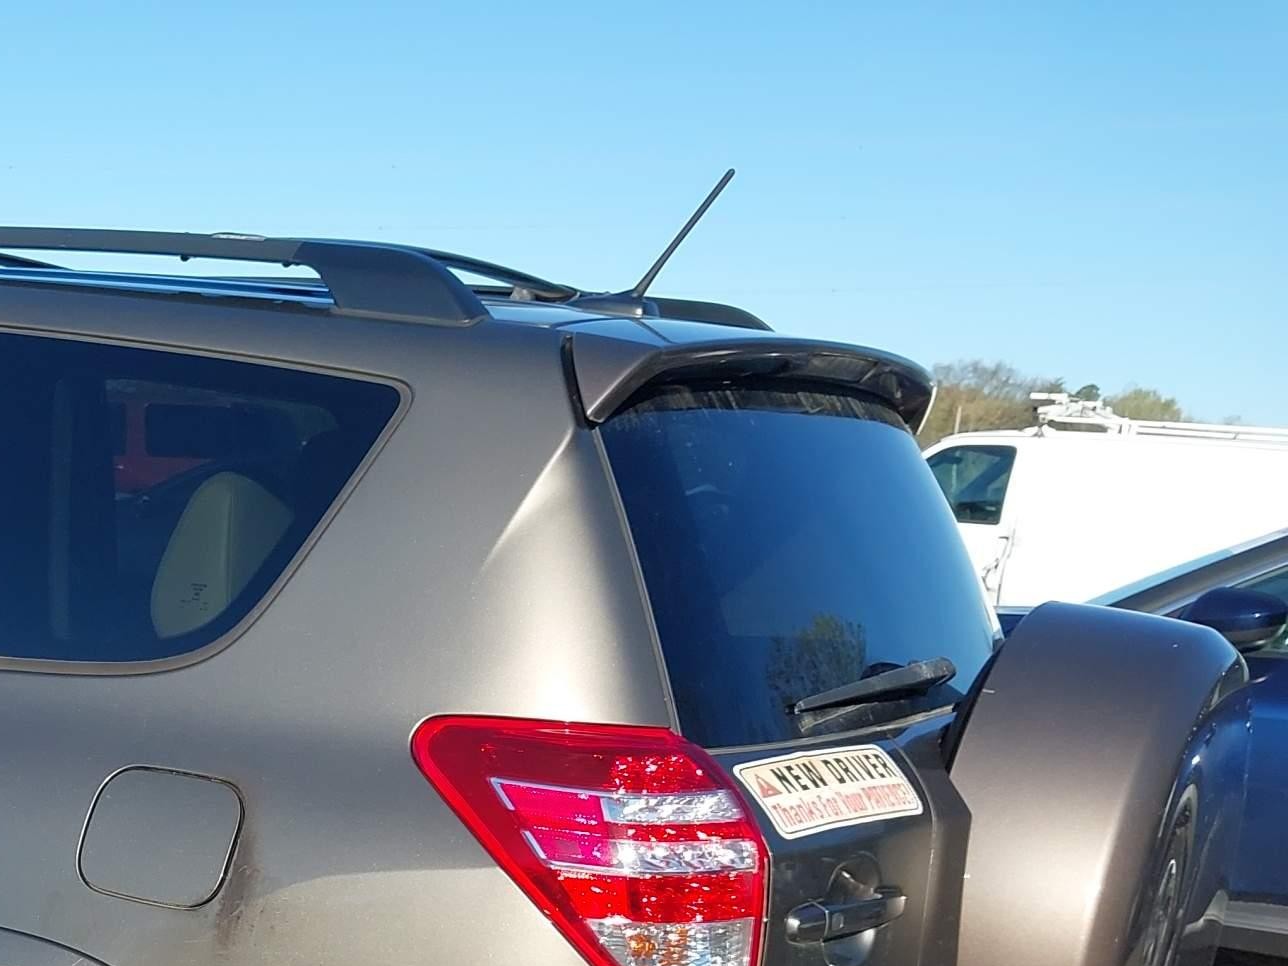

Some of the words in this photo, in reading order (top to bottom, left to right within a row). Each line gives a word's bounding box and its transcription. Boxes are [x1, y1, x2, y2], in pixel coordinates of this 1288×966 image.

[770, 761, 828, 793] NEW
[820, 754, 897, 784] DRIVER
[773, 797, 825, 828] Thanks
[817, 794, 842, 816] For
